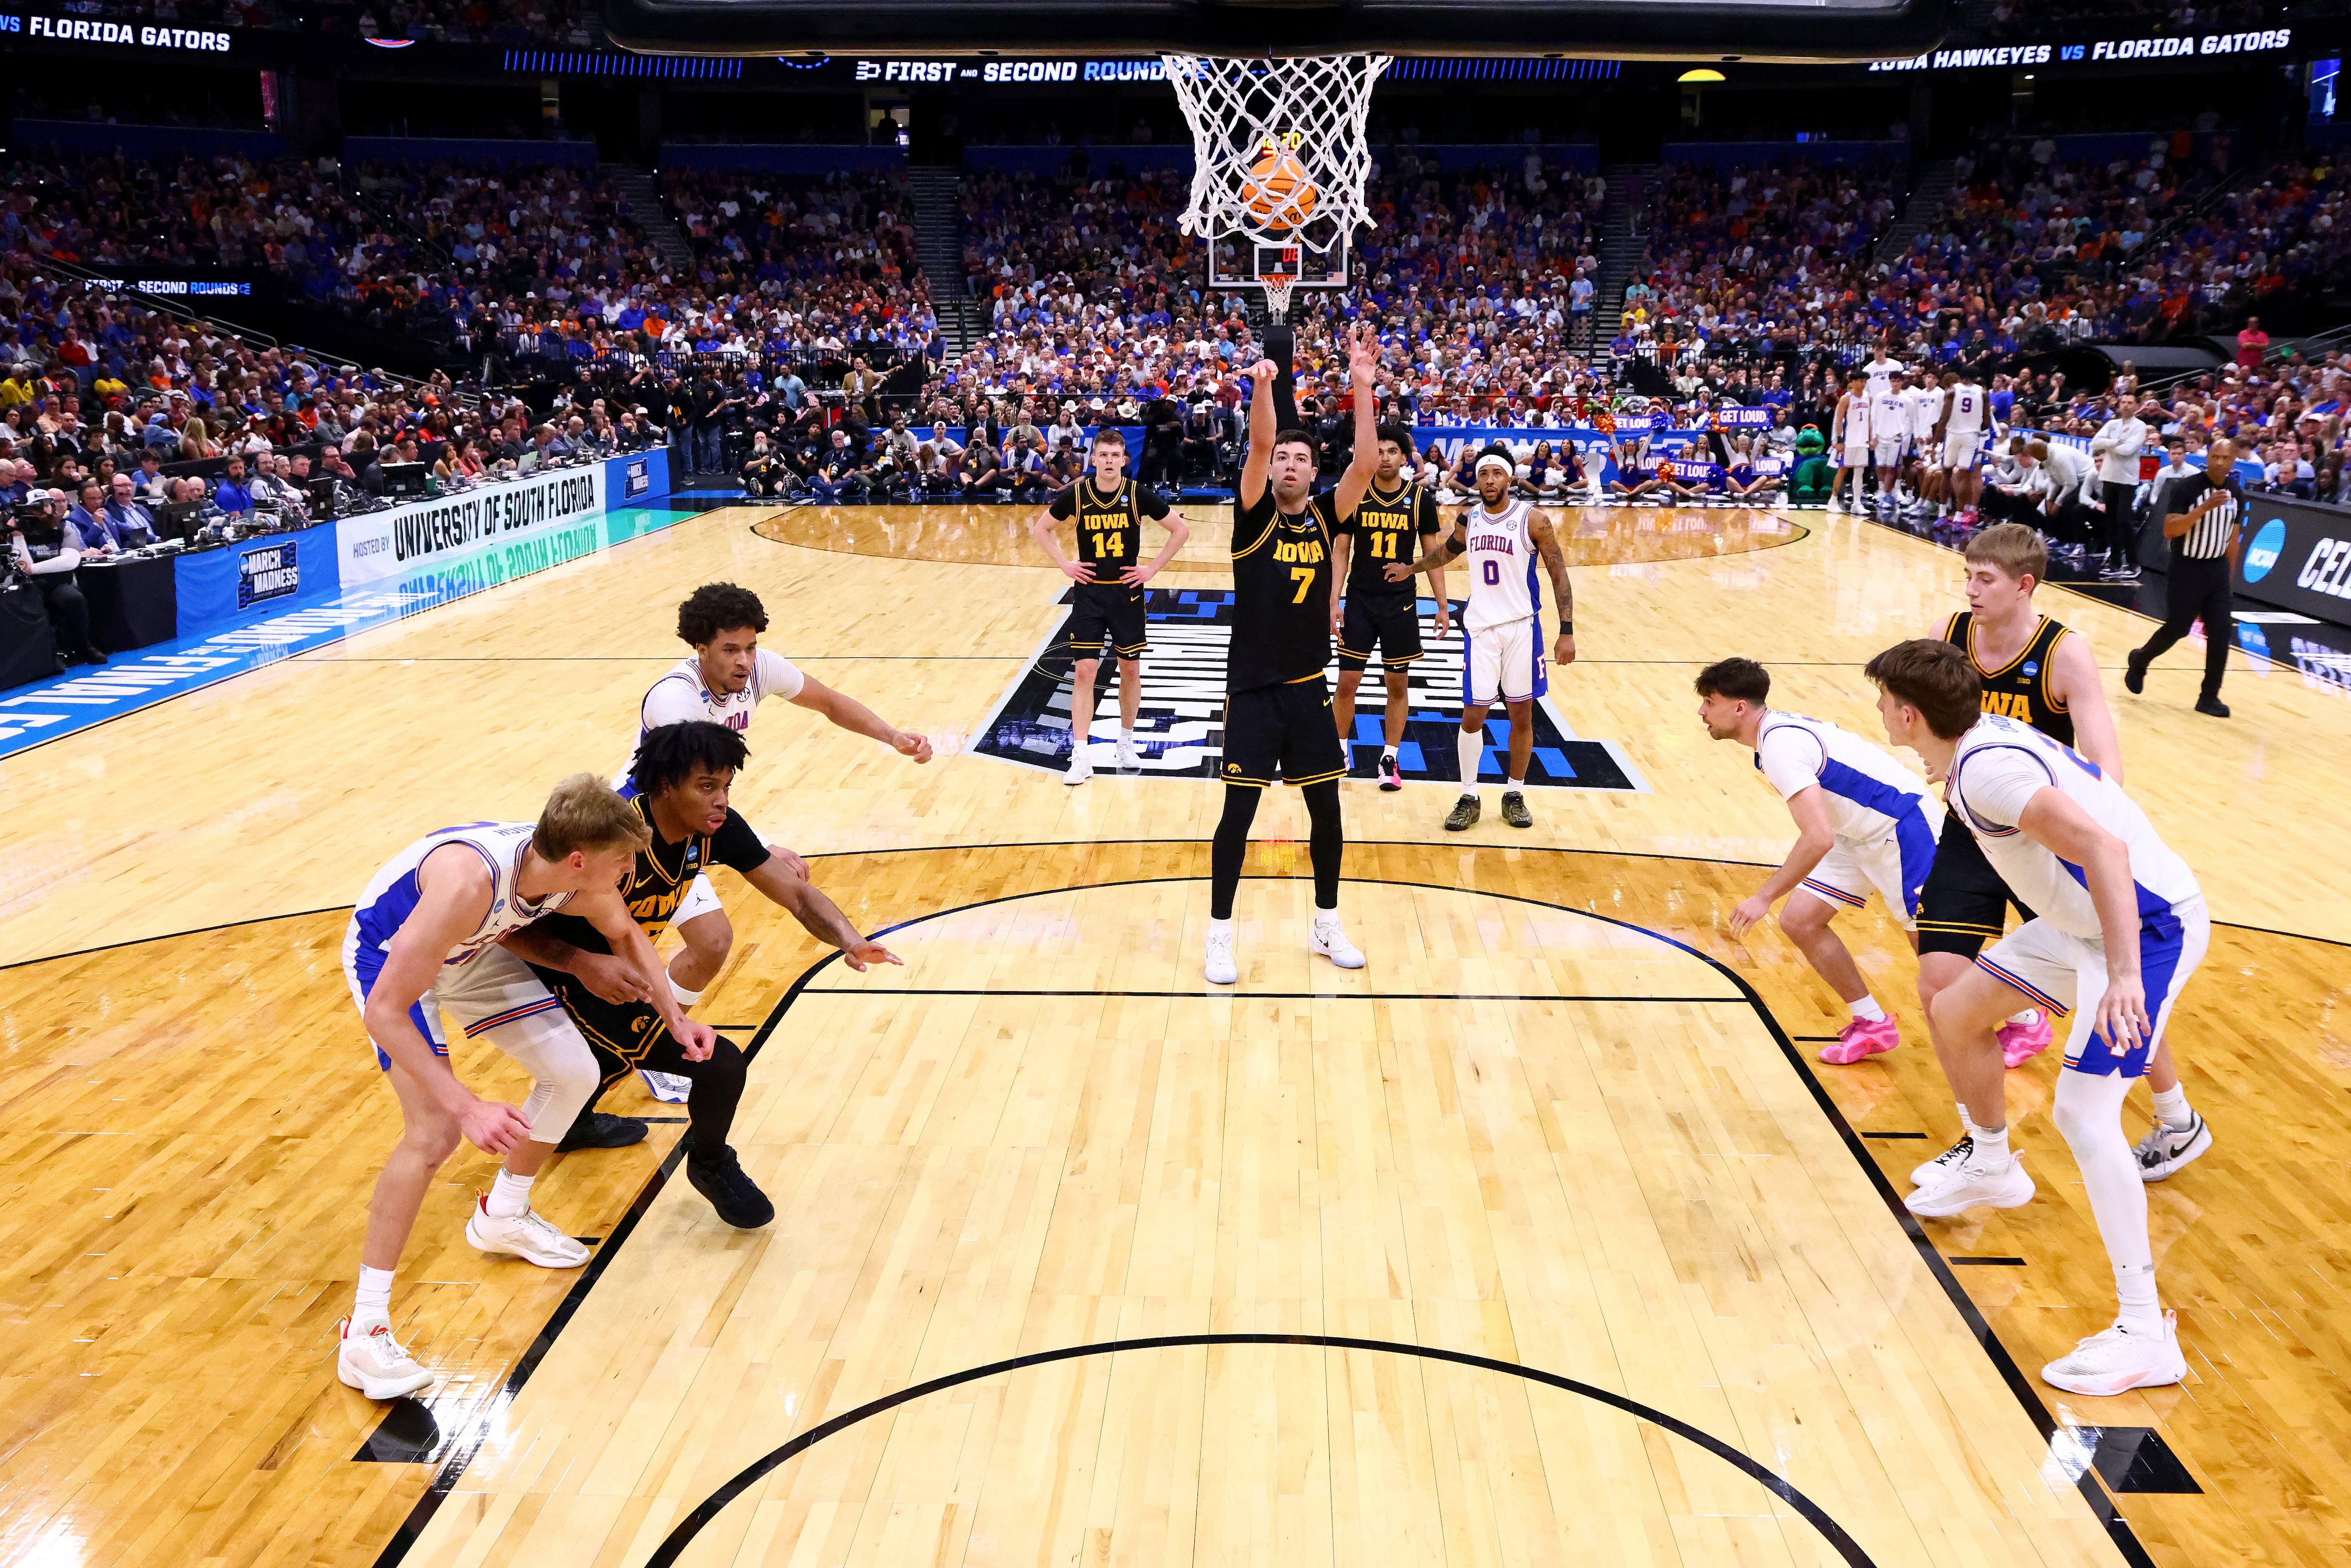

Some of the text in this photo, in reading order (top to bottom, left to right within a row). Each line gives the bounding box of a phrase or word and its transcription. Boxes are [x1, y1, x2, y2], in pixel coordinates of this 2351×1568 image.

[0, 16, 230, 51] VS FLORIDA GATORS
[1933, 45, 2051, 69] HAWKEYES
[2060, 45, 2085, 62] VS
[2092, 37, 2194, 60] FLORIDA
[2200, 29, 2291, 55] GATORS
[885, 62, 956, 81] FIRST
[960, 69, 978, 78] AND
[983, 62, 1077, 81] SECOND
[138, 281, 187, 294] SECOND
[190, 283, 238, 295] ROUNDS
[1720, 410, 1767, 423] GET LOUD
[1962, 397, 1972, 413] 9
[1674, 463, 1686, 475] ET
[1755, 459, 1781, 472] LOUD
[633, 474, 648, 490] MADNESS
[353, 474, 594, 561] HOSTED BY UNIVERSITY OF SOUTH FLORIDA
[1084, 513, 1129, 530] IOWA
[1362, 512, 1409, 530] IOWA
[1092, 532, 1124, 558] 14
[1273, 539, 1324, 564] IOWA
[1371, 531, 1397, 559] 11
[1470, 535, 1514, 556] FLORIDA
[248, 550, 281, 575] MARCH
[2246, 548, 2279, 568] NCAA
[254, 567, 298, 593] MADNESS
[1291, 567, 1315, 603] 7
[1483, 560, 1499, 585] 0
[205, 608, 387, 644] ROAD
[0, 656, 241, 706] FINAL
[1980, 690, 2033, 723] WA
[492, 824, 538, 836] AUGH
